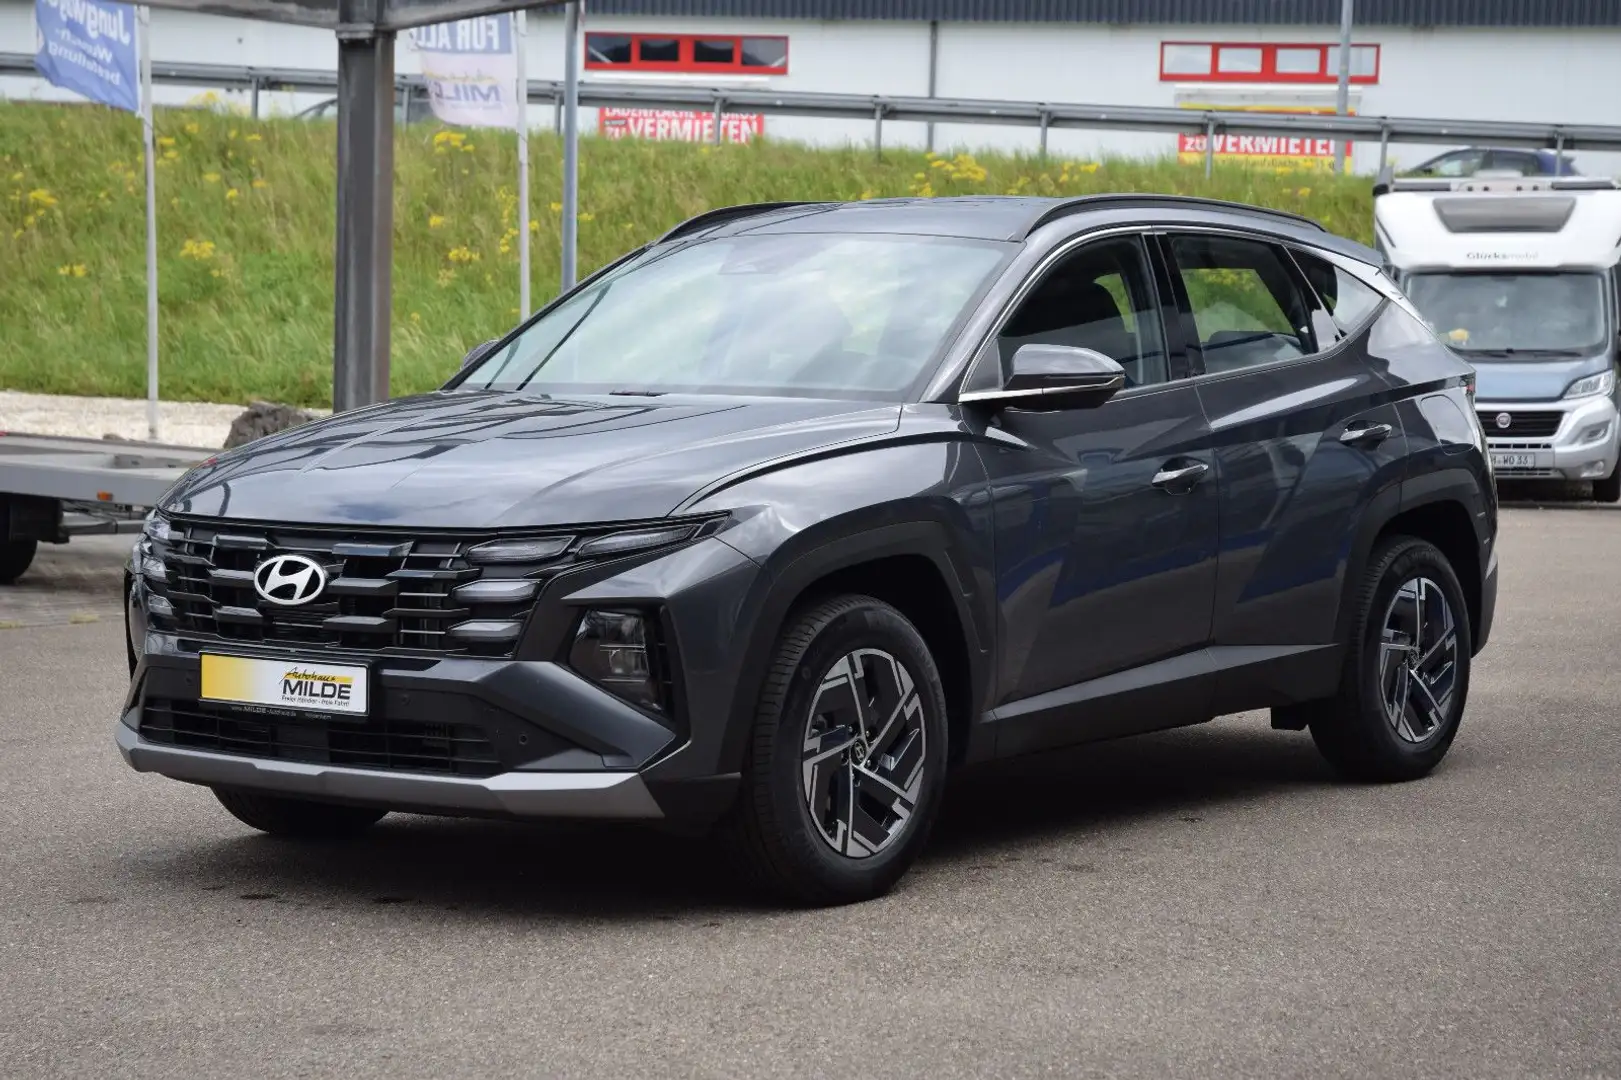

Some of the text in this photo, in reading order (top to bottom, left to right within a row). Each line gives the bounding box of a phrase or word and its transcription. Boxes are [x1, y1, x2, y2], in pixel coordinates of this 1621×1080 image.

[1213, 134, 1335, 156] VERMIETE
[279, 666, 337, 684] Autohaus
[282, 679, 352, 700] MILDE
